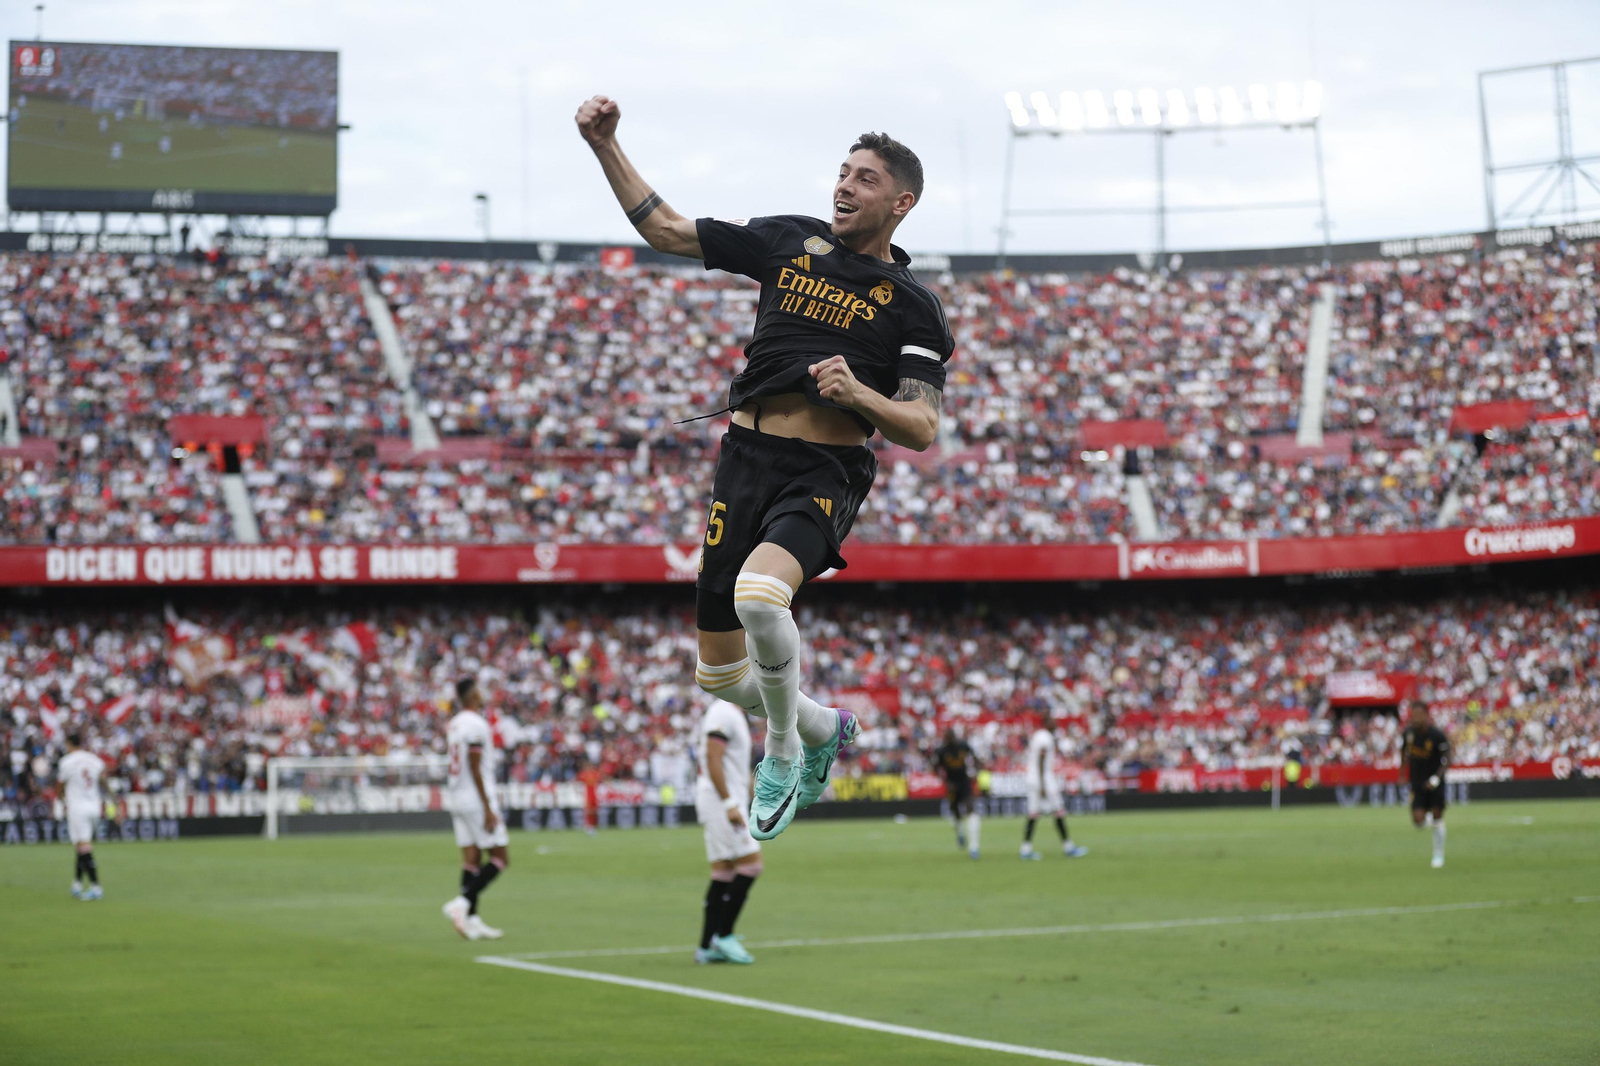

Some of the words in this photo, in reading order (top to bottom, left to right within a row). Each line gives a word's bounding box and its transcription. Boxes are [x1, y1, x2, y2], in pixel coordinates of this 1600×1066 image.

[777, 267, 877, 320] Emirates
[780, 293, 805, 313] FLY
[803, 299, 855, 329] BETTER
[1464, 524, 1576, 556] Cruzcampo
[46, 546, 137, 581] DICEN
[144, 546, 206, 583] QUE
[212, 546, 315, 580] NUNCA
[319, 545, 358, 580] SE
[369, 545, 459, 579] RINDE
